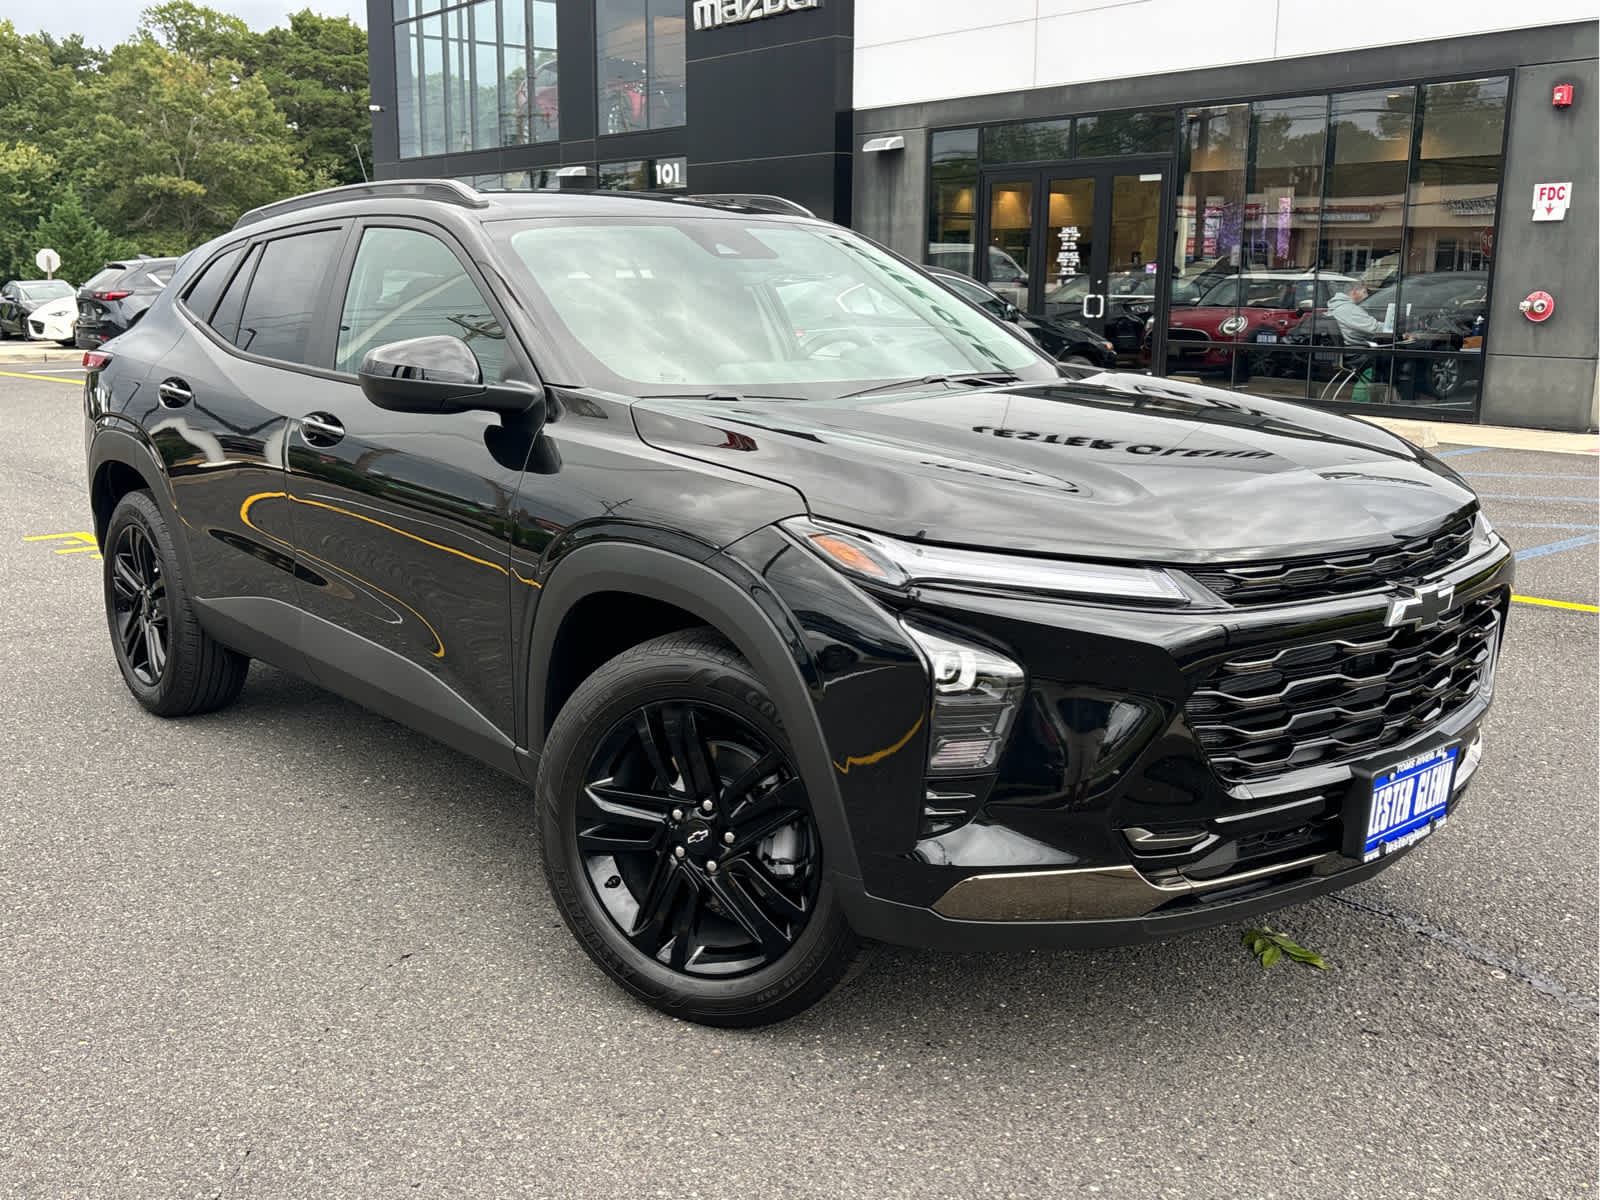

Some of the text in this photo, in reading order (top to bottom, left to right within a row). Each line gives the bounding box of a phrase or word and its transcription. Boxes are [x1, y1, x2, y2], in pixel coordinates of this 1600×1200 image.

[656, 163, 680, 185] 101
[1539, 186, 1566, 201] FDC
[1367, 760, 1454, 838] LESTER GLENN
